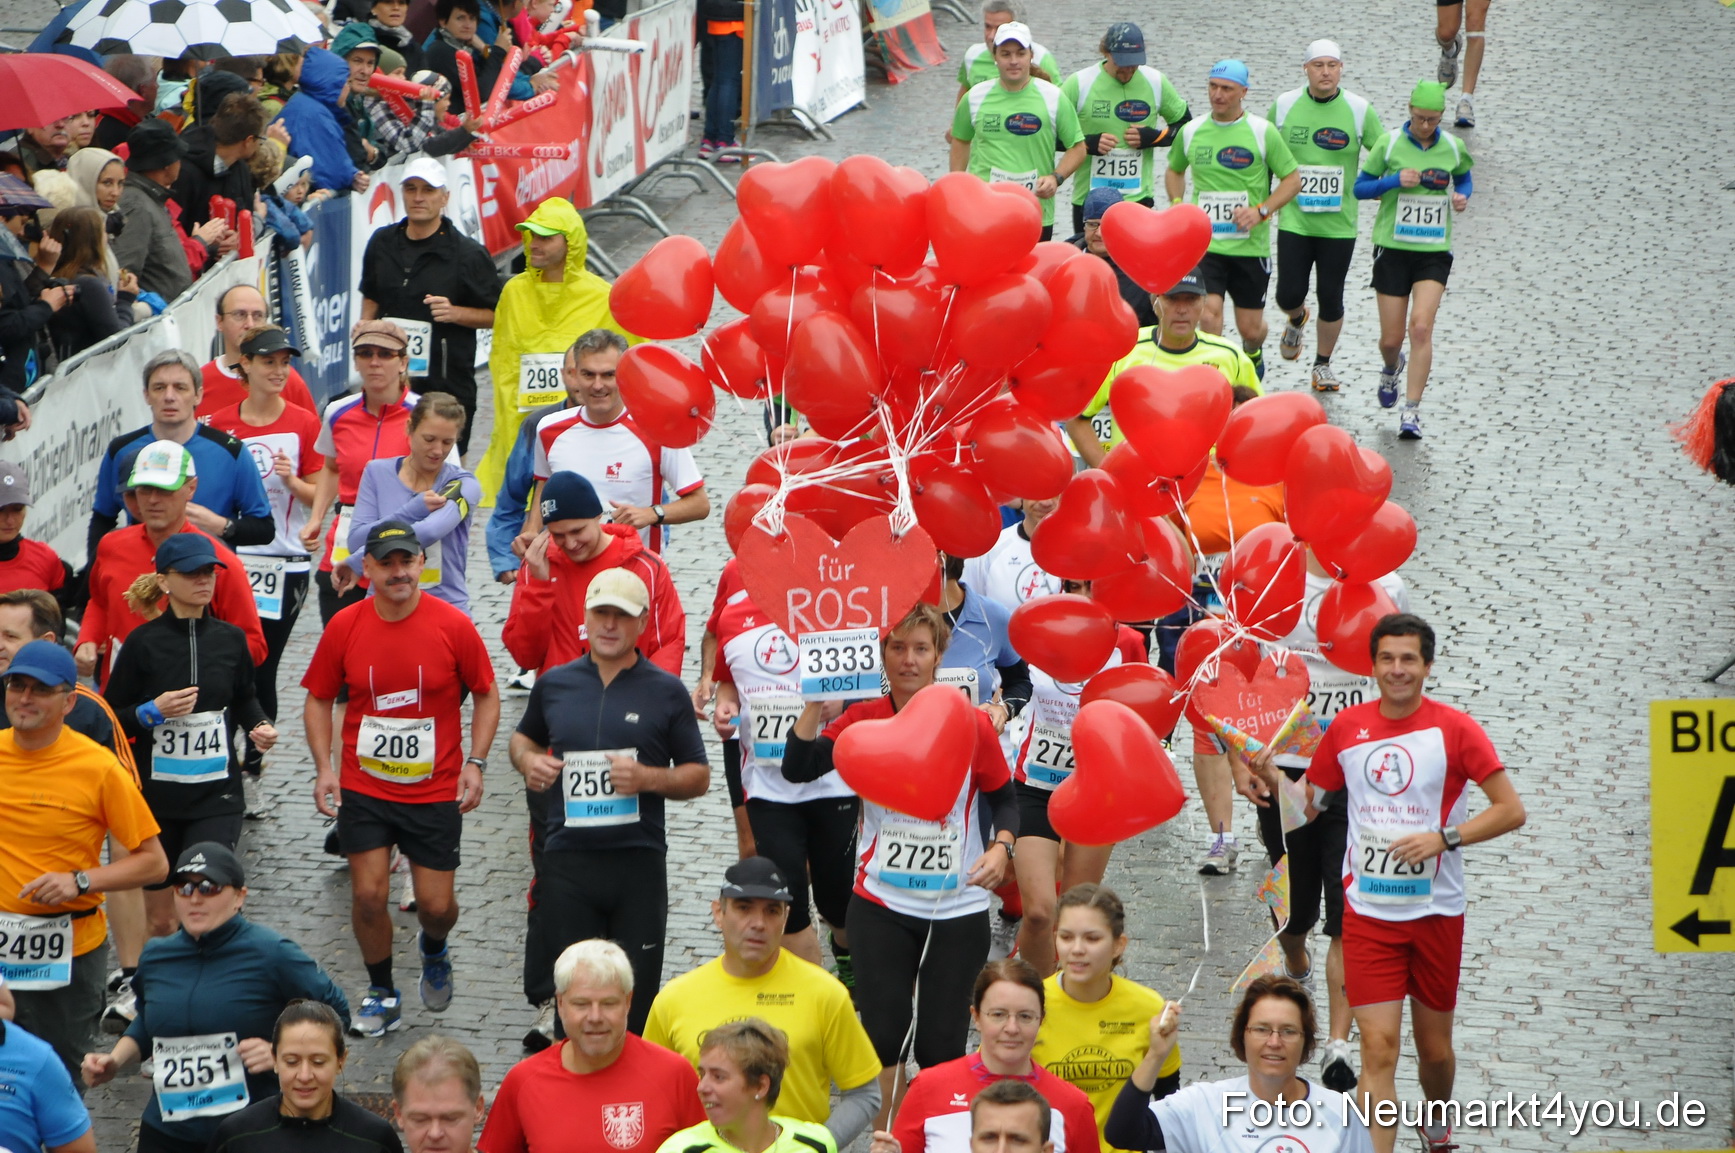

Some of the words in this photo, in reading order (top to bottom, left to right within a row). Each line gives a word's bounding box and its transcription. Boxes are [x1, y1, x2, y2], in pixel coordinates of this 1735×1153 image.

[494, 146, 521, 156] BKK
[1096, 158, 1138, 177] 2155
[1300, 176, 1339, 194] 2209
[1203, 203, 1244, 221] 215
[1402, 206, 1442, 224] 2151
[1213, 223, 1233, 233] Oliver
[288, 259, 303, 291] BMW
[527, 368, 559, 390] 298
[527, 394, 559, 404] Christian
[818, 554, 855, 582] für
[786, 585, 889, 635] ROSI
[800, 637, 827, 646] PARTL
[828, 633, 867, 644] Neumarkt
[807, 644, 876, 674] 3333
[1323, 680, 1357, 688] Neumarkt
[386, 695, 406, 705] DEHN
[1037, 696, 1064, 707] LAUFEN
[1238, 691, 1263, 711] für
[182, 720, 214, 728] Neumarkt
[1034, 726, 1056, 738] PARTL
[161, 727, 222, 756] 3144
[373, 733, 419, 759] 208
[381, 763, 410, 775] Mario
[586, 804, 615, 816] Peter
[882, 828, 907, 839] PARTL
[909, 832, 946, 841] Neumarkt
[886, 842, 952, 870] 2725
[908, 876, 927, 888] Eva
[1368, 880, 1417, 894] Johannes
[0, 931, 65, 961] 2499
[164, 1053, 231, 1088] 2551
[1055, 1062, 1124, 1079] FRANCESCO
